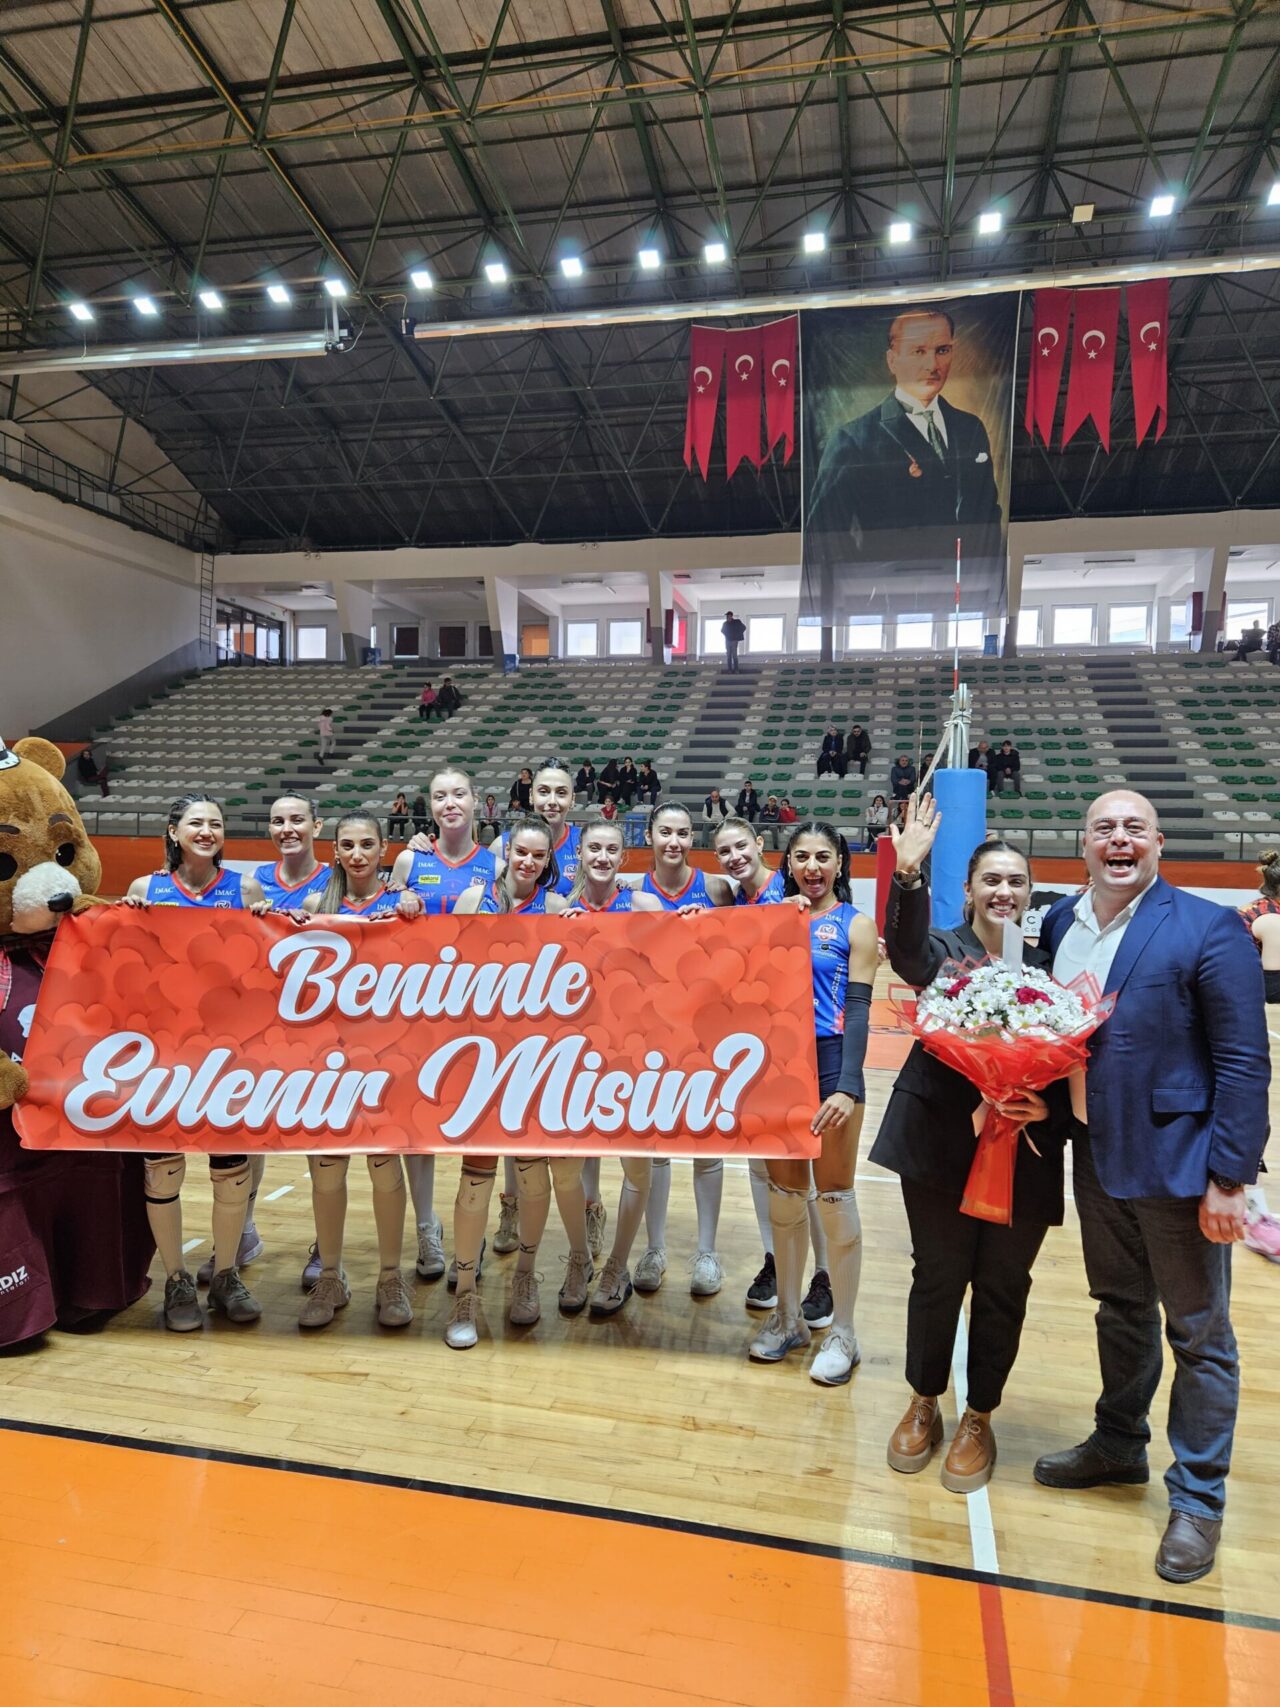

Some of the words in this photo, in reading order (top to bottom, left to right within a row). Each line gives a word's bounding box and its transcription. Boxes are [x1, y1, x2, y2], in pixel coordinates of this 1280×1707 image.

[268, 930, 592, 1022] Benimle
[64, 1031, 390, 1132] Evlenir
[417, 1032, 766, 1138] Misin?
